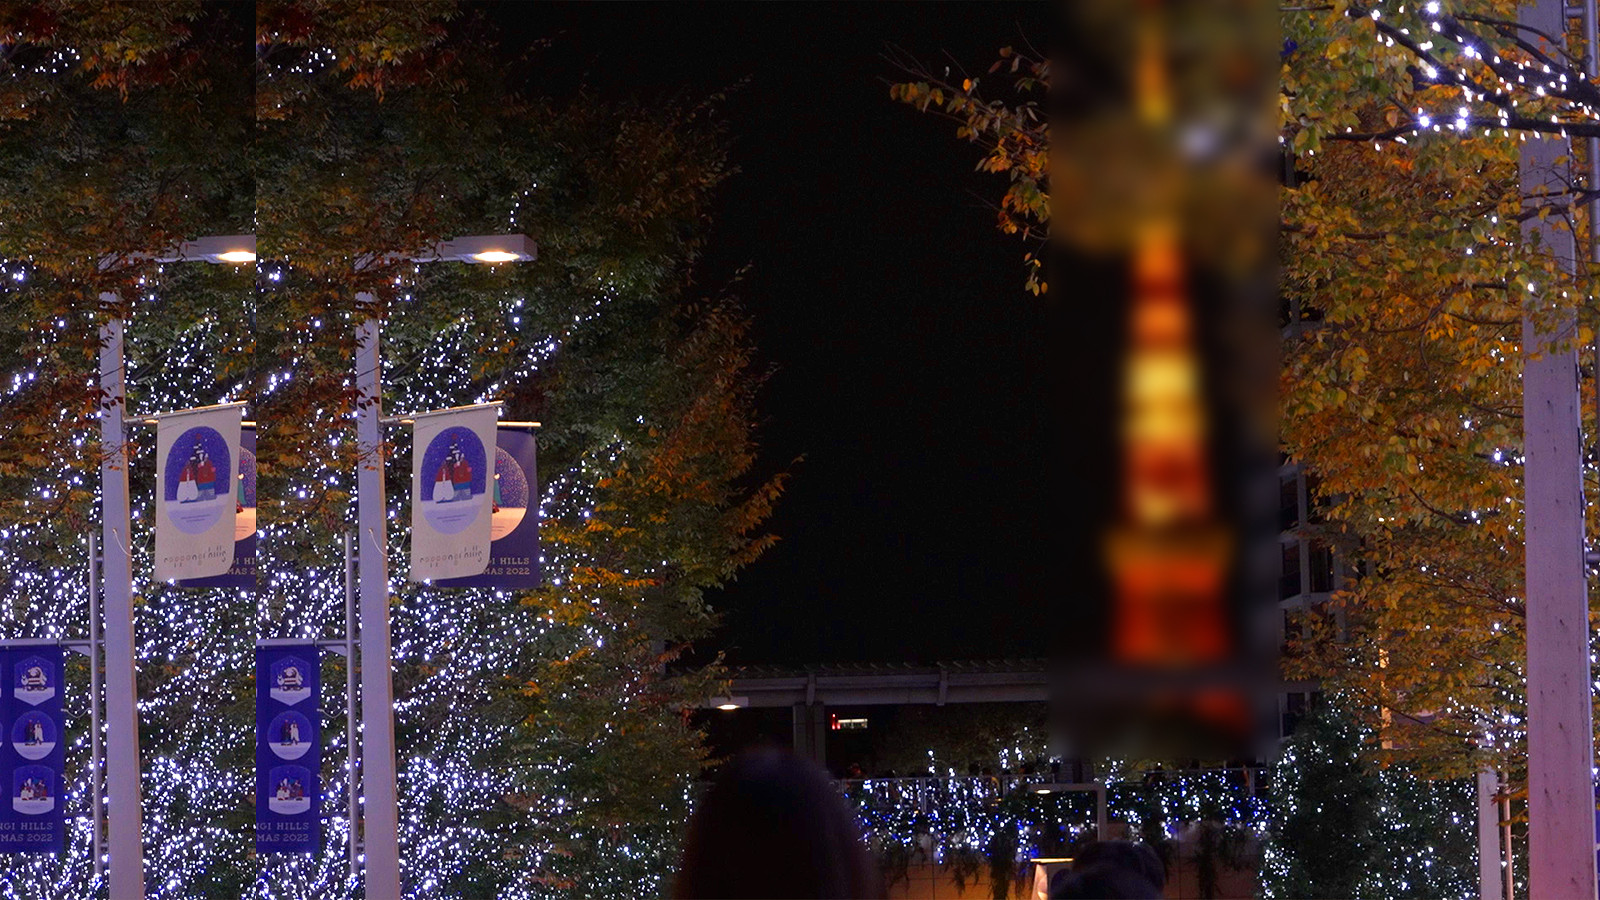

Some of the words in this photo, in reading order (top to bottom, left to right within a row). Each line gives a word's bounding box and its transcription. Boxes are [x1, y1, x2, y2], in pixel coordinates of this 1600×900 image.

[500, 557, 530, 565] HILLS
[506, 567, 531, 575] 2022
[20, 822, 54, 830] HILLS
[276, 822, 310, 830] HILLS
[27, 833, 53, 842] 2022
[283, 833, 309, 842] 2022
